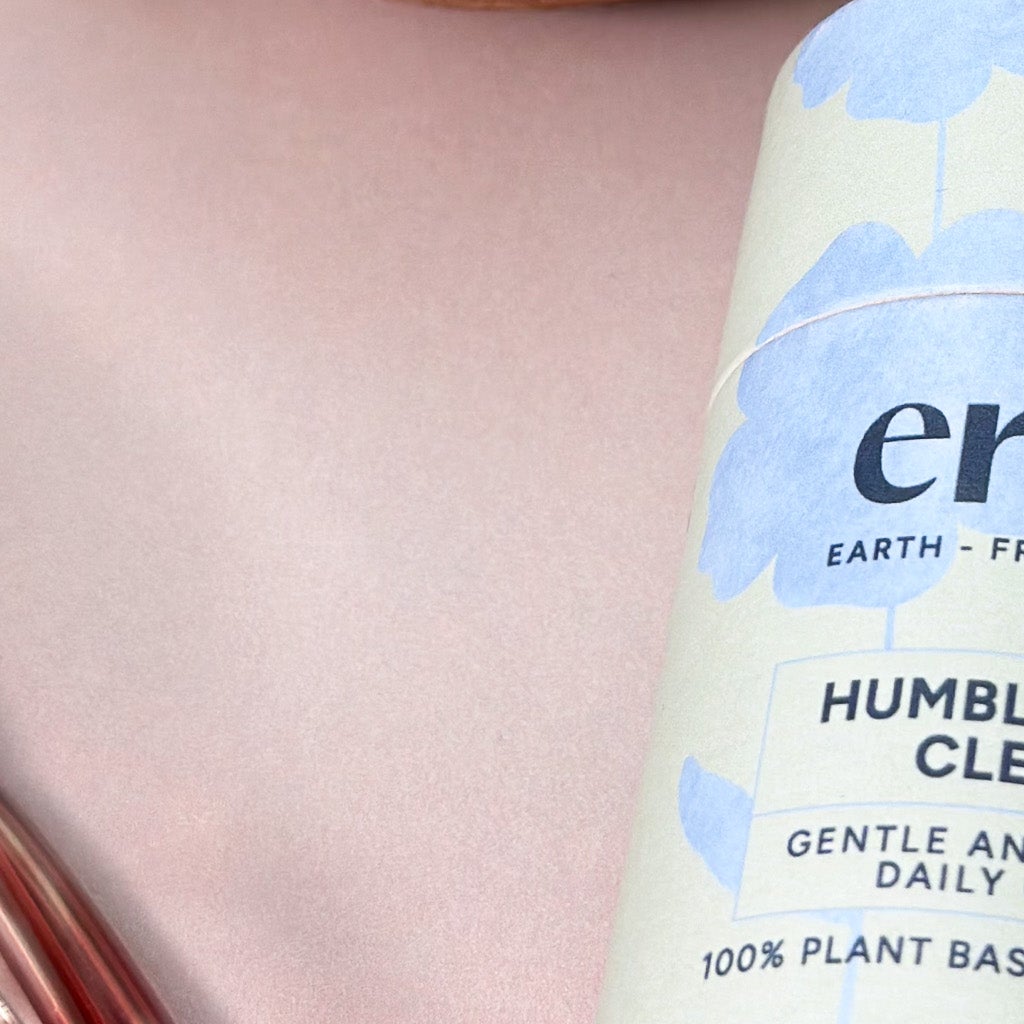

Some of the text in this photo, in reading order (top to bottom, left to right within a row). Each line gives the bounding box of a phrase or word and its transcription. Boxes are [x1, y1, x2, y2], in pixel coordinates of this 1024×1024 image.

[826, 535, 943, 567] EARTH
[786, 825, 949, 859] GENTLE
[875, 860, 1003, 897] DAILY
[701, 938, 786, 980] 100%
[800, 936, 933, 968] PLANT
